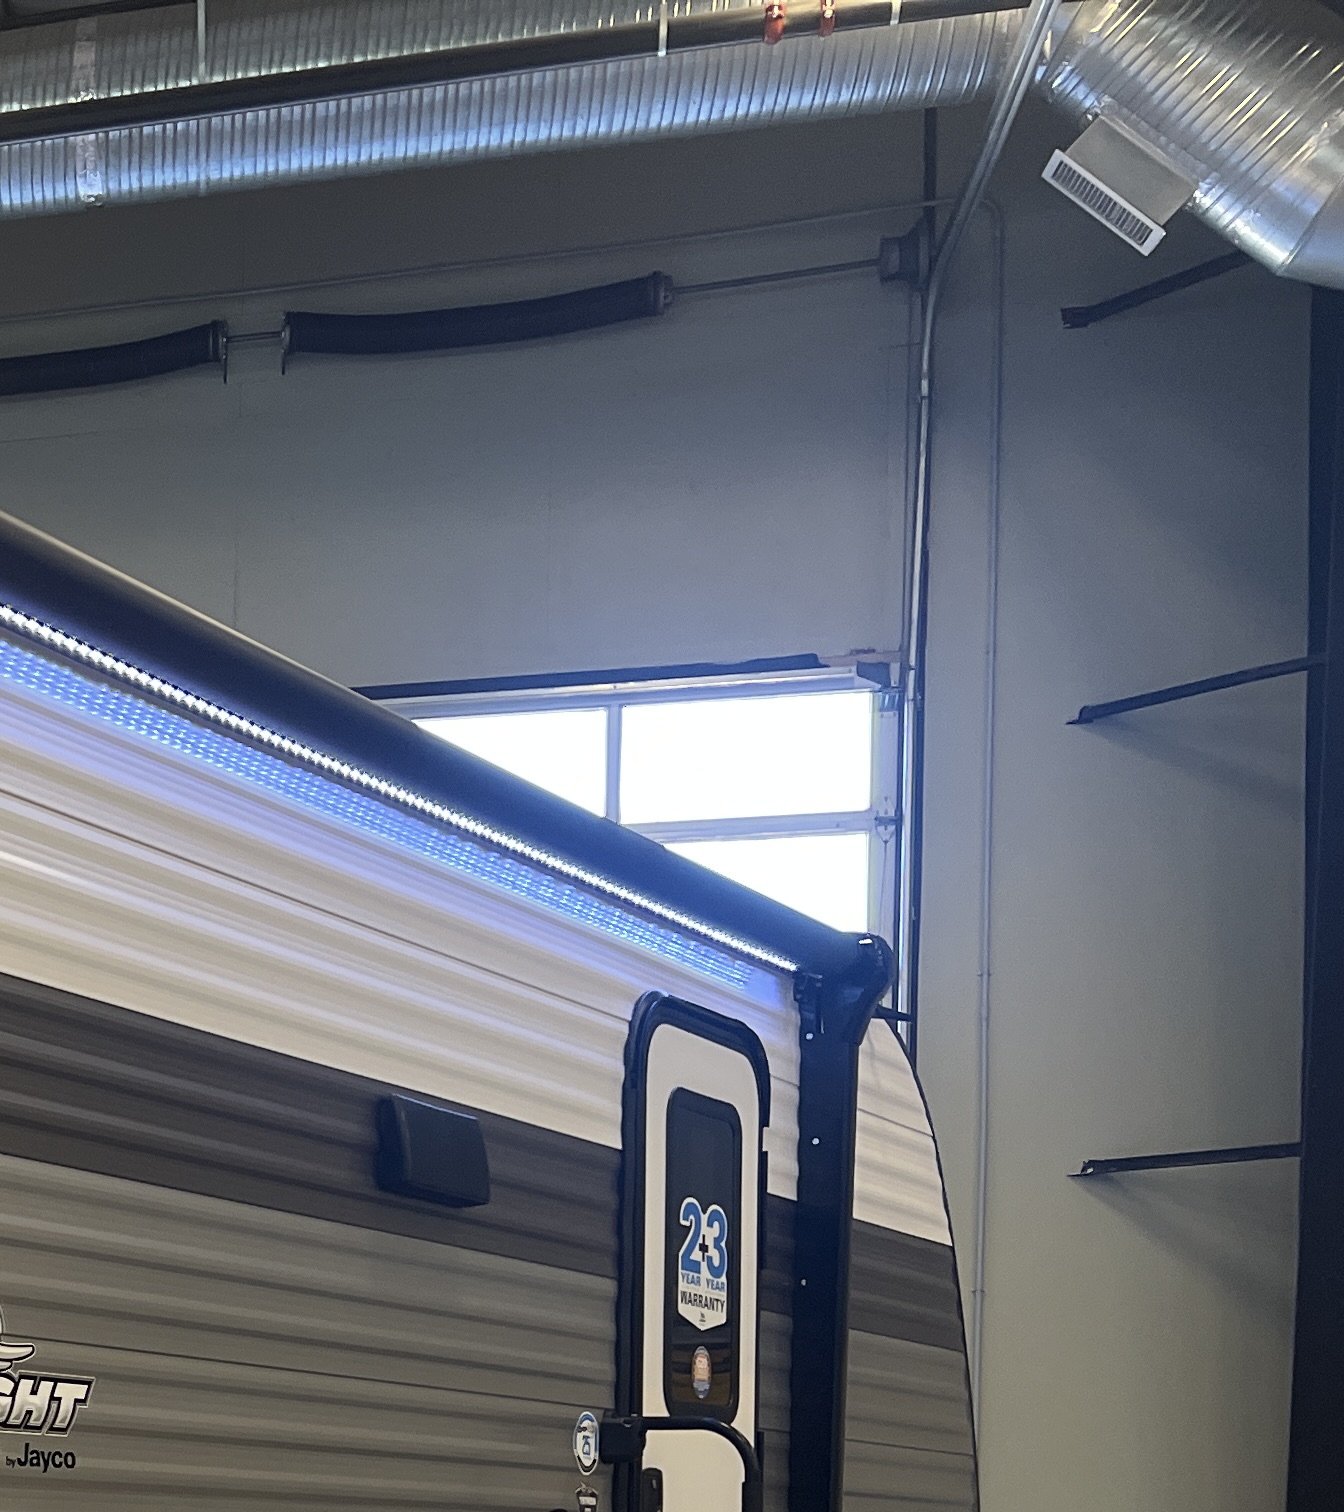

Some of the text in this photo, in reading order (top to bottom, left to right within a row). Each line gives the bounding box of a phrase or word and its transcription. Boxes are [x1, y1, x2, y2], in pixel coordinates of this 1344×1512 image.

[680, 1272, 726, 1293] YEAR YEAR
[680, 1290, 726, 1314] WARRANTY
[17, 1442, 76, 1475] Jayco
